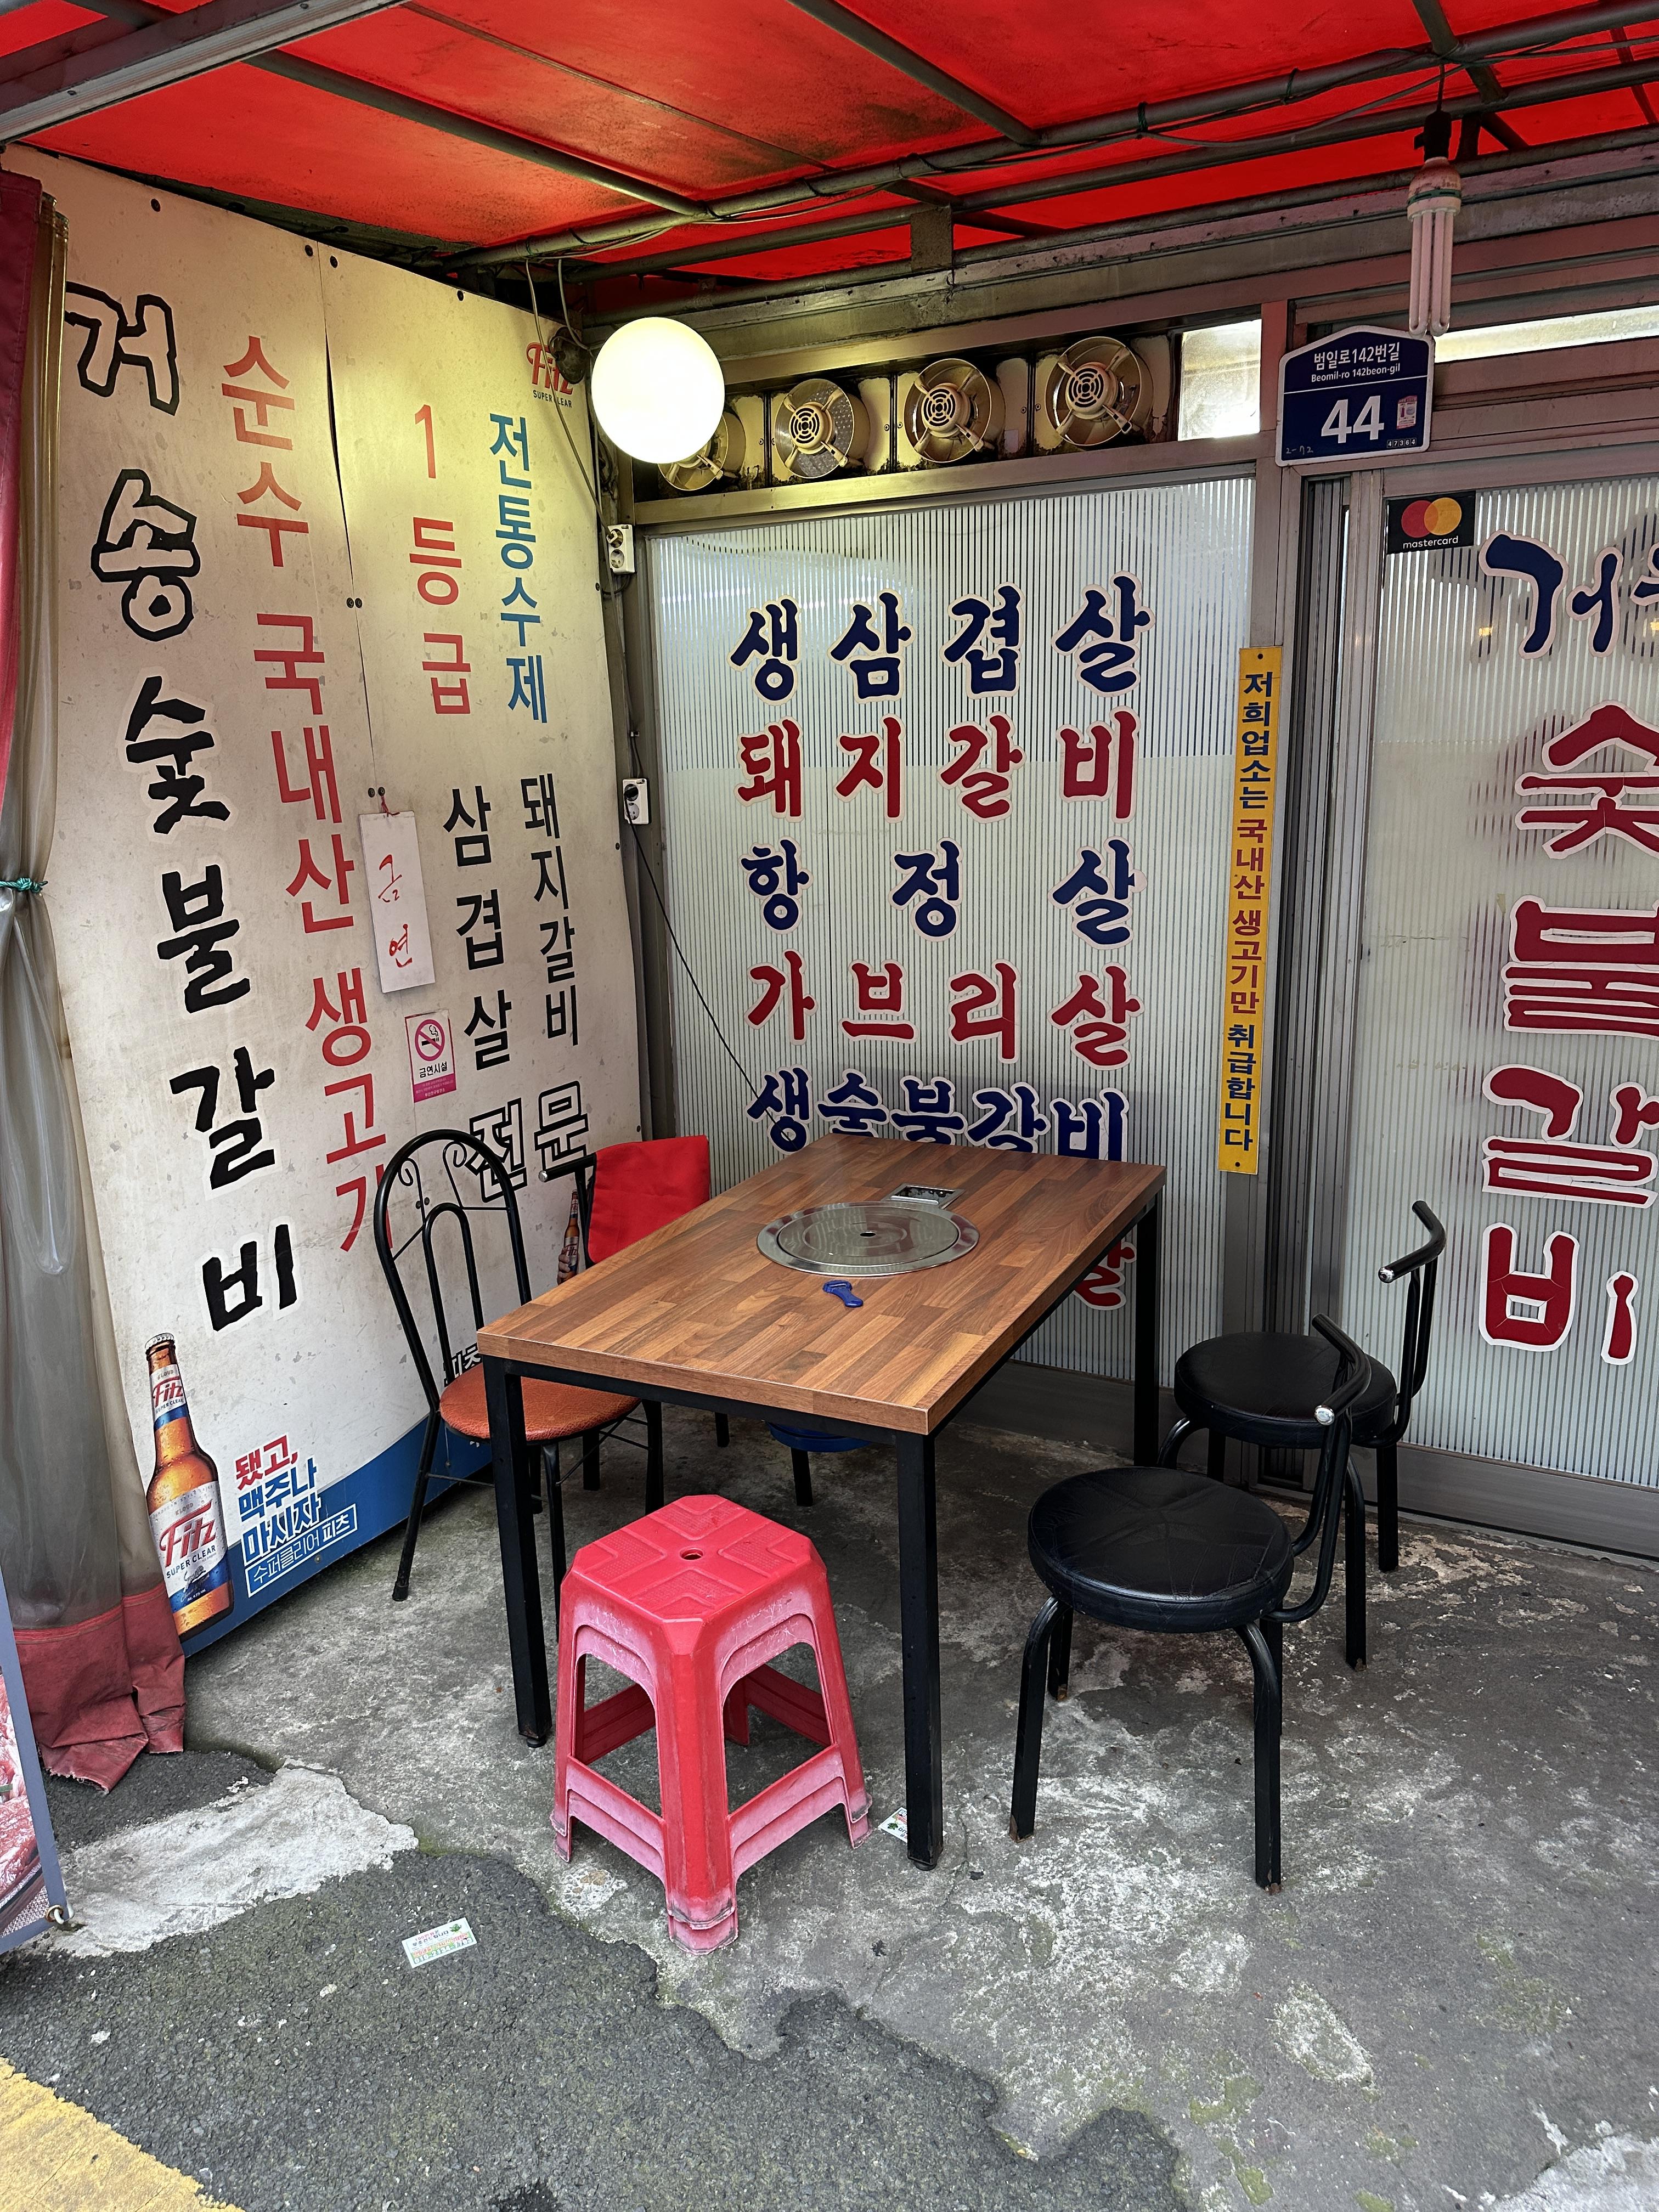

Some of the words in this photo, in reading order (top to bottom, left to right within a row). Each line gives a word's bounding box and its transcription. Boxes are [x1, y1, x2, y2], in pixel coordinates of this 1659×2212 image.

[533, 389, 553, 403] SUPER
[556, 396, 572, 408] LEAR
[1311, 370, 1350, 382] Beomil-ro
[1352, 362, 1401, 377] 142beon-gil
[221, 335, 310, 568] 순수
[1321, 394, 1385, 444] 44
[489, 413, 548, 724] 전통수제
[1402, 535, 1459, 550] mastercard
[253, 613, 356, 935] 국내산
[1233, 817, 1269, 901] 국내산
[442, 785, 512, 1071] 삼겹살
[520, 773, 579, 1046] 돼지갈비
[1229, 907, 1265, 1016] 생고기만
[419, 1061, 448, 1079] 금연시설
[1223, 1024, 1257, 1152] 취급합니다
[152, 1376, 184, 1408] Fitz
[238, 1457, 317, 1523] 맥주나
[159, 1499, 217, 1568] Fitz
[166, 1559, 191, 1579] SUPER
[191, 1544, 217, 1563] CLEAR
[242, 1491, 321, 1564] 마시자
[321, 1513, 349, 1542] 피츠
